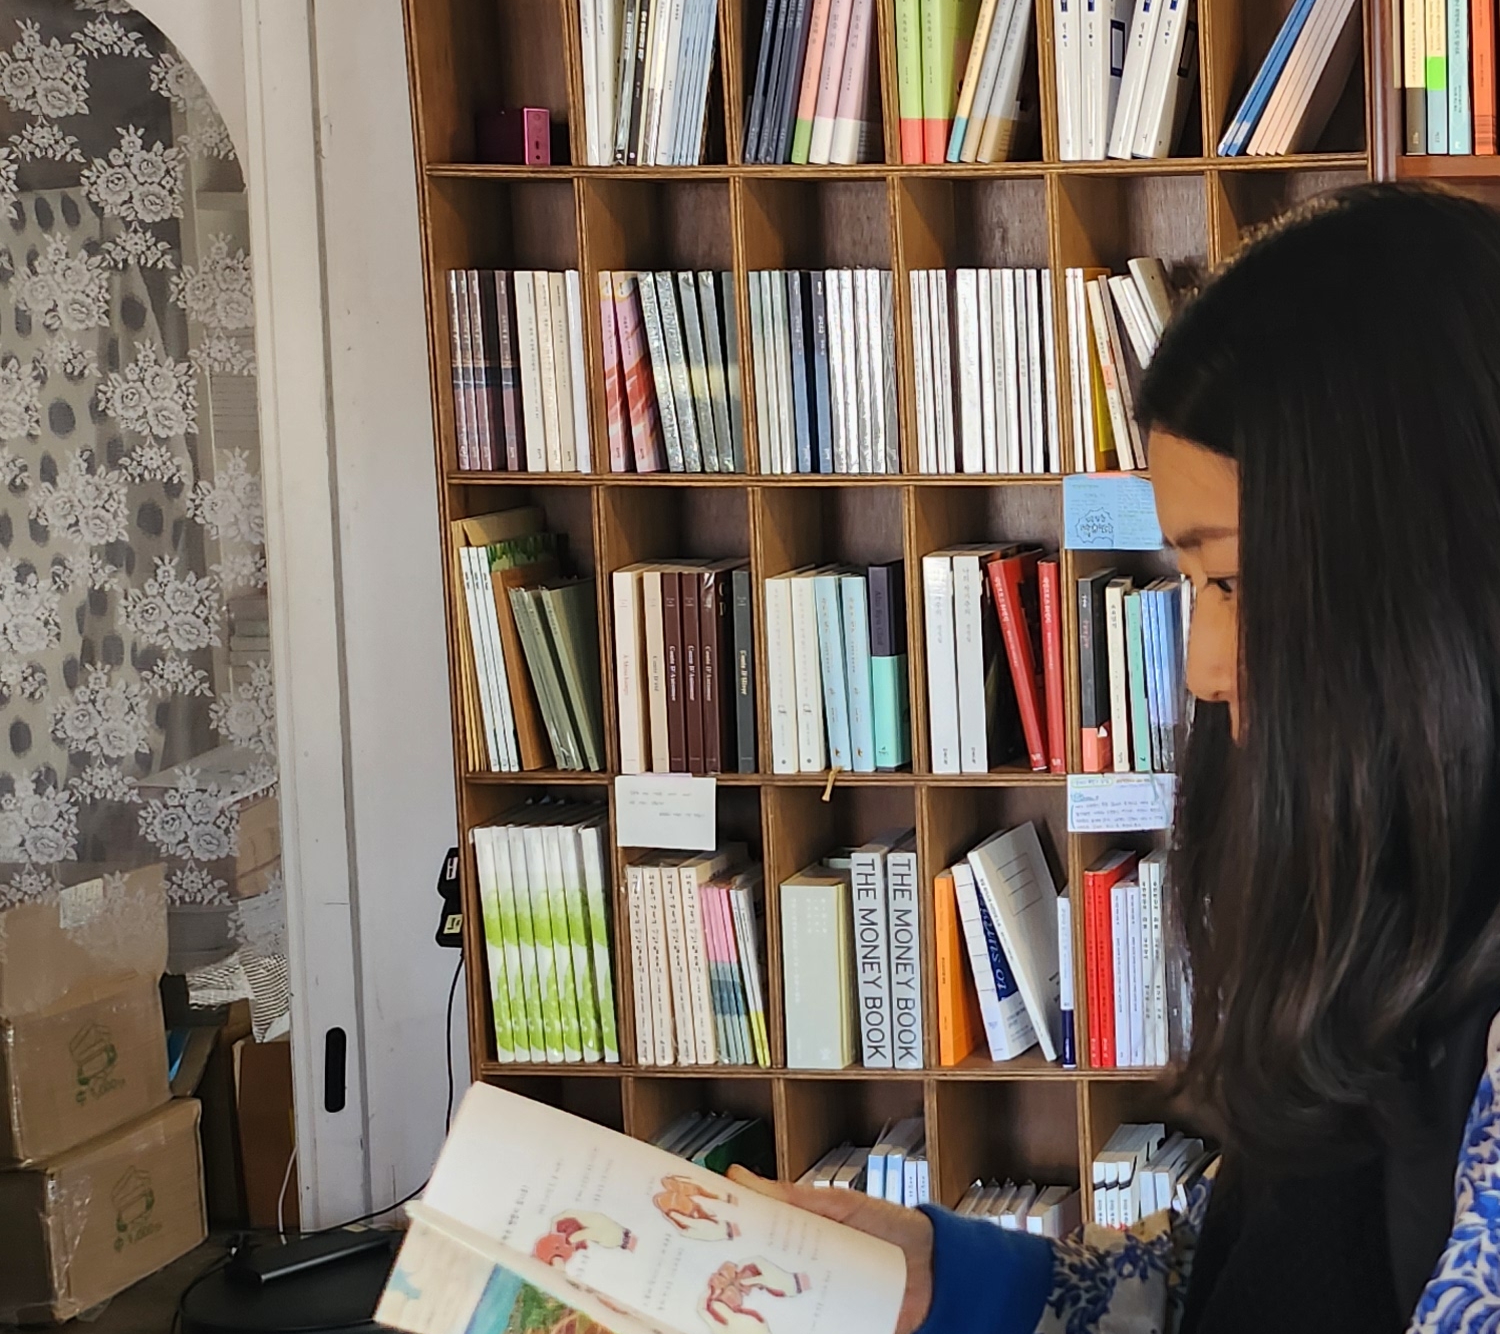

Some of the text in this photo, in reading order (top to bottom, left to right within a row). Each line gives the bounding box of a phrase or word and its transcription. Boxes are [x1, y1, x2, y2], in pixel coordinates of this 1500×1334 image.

[856, 858, 888, 1061] THE MONEY BOOK
[892, 858, 918, 1061] THE MONEY BOOK
